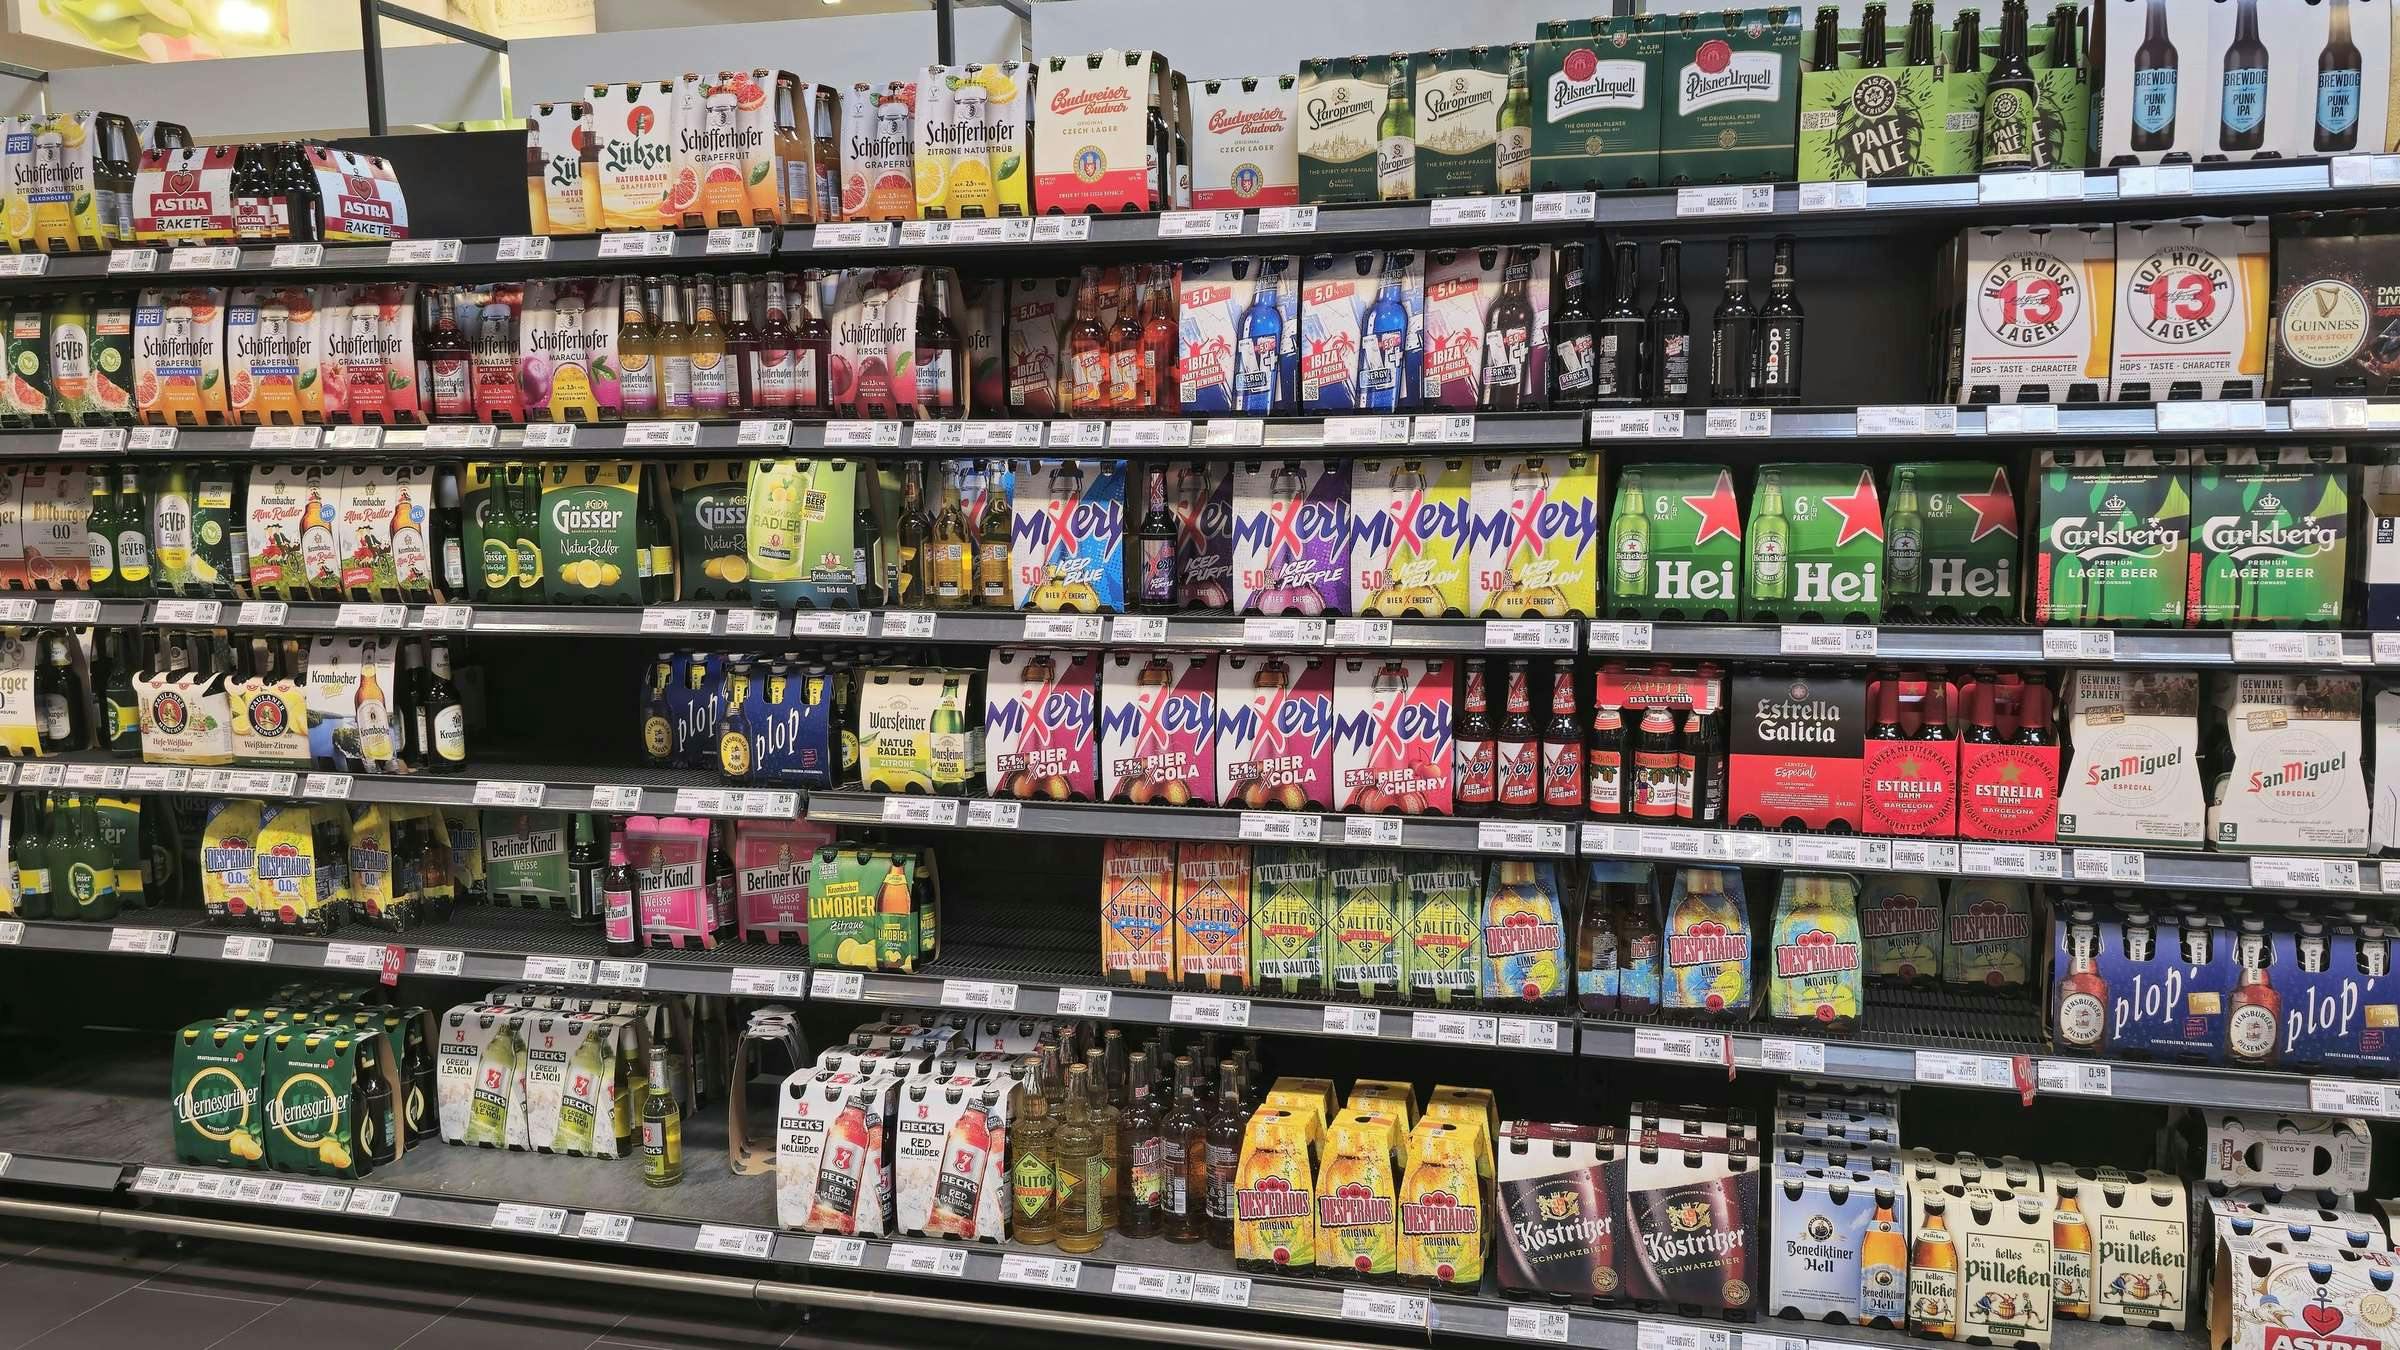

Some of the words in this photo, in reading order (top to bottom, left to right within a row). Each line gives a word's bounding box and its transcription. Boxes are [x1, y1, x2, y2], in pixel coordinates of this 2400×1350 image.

[2135, 71, 2177, 86] BREWDOG
[2224, 72, 2267, 86] BREWDOG
[1855, 78, 1889, 102] MAISEL
[1051, 86, 1131, 114] Budweiser
[1425, 88, 1493, 122] Staropramen
[1867, 97, 1892, 115] FRIENDS
[2144, 93, 2165, 105] PUNK
[2233, 93, 2255, 105] PUNK
[1083, 102, 1128, 116] Budvar
[1307, 98, 1375, 130] Staropramen
[2147, 105, 2160, 116] IPA
[2237, 106, 2250, 116] IPA
[925, 118, 1014, 147] Schöfferhofer
[1062, 126, 1089, 135] CZECH
[1092, 125, 1118, 134] LAGER
[1852, 120, 1903, 153] PALE
[8, 140, 31, 154] FREI
[680, 126, 764, 157] Schöfferhofer
[694, 151, 750, 162] GRAPEFRUIT
[927, 146, 961, 156] ZITRONE
[963, 145, 1013, 155] NATURTRÜB
[1861, 142, 1909, 179] ALE
[15, 163, 84, 186] Schöfferhofer
[153, 198, 209, 214] ASTRA
[156, 218, 210, 231] RAKETE
[1985, 259, 2018, 297] HOP
[2022, 257, 2074, 297] HOUSE
[1996, 279, 2063, 325] 13
[1997, 320, 2058, 343] LAGER
[2291, 318, 2359, 332] GUINNESS
[840, 321, 907, 345] Schöfferhofer
[2294, 333, 2319, 342] EXTRA
[2323, 333, 2354, 341] STOUT
[142, 334, 214, 359] Schöfferhofer
[328, 335, 402, 358] Schöfferhofer
[530, 329, 608, 353] Schöfferhofer
[550, 353, 590, 362] MARACUJA
[857, 347, 888, 356] KIRSCHE
[155, 359, 202, 368] GRAPEFRUIT
[338, 357, 393, 366] GRANATAPFEL
[1311, 351, 1340, 370] IBIZA
[1304, 363, 1343, 379] PARTY-REISEN
[1970, 364, 1992, 374] HOPS
[2000, 364, 2023, 374] TASTE
[2031, 363, 2077, 373] CHARACTER
[260, 496, 296, 507] Krombacher
[806, 497, 826, 507] BEER
[1655, 496, 1668, 514] 6
[252, 508, 271, 521] Alm
[271, 506, 302, 521] Radler
[320, 509, 334, 519] NEU
[552, 498, 623, 534] Gösser
[1653, 513, 1670, 521] PACK
[159, 512, 187, 531] JEVER
[753, 515, 799, 532] RADLER
[2050, 515, 2180, 557] Carlsberg
[1616, 551, 1649, 561] Heineken
[1055, 559, 1090, 574] ICED
[1279, 558, 1318, 577] ICED
[2068, 568, 2115, 579] LAGER
[2121, 568, 2158, 579] BEER
[1063, 567, 1103, 587] BLUE
[1281, 567, 1344, 592] PURPLE
[1518, 569, 1584, 590] YELLOW
[1655, 560, 1736, 599] Hei
[2045, 640, 2078, 651] MEHRWEG
[311, 671, 357, 687] Krombacher
[2080, 675, 2121, 687] GEWINNE
[1629, 693, 1693, 704] naturtrüb
[2080, 690, 2121, 700] SPANIEN
[249, 695, 286, 713] PAULANER
[1755, 699, 1841, 722] Estrella
[869, 712, 926, 731] Warsteiner
[253, 723, 287, 738] MÜNCHEN
[1757, 718, 1837, 743] Galicia
[880, 738, 914, 748] NATUR
[877, 747, 917, 758] RADLER
[1029, 748, 1068, 764] BIER
[880, 759, 915, 767] ZITRONE
[1036, 761, 1080, 776] COLA
[1379, 768, 1414, 783] BIER
[1775, 766, 1816, 779] Especial
[1386, 776, 1447, 795] CHERRY
[1877, 780, 1942, 793] ESTRELLA
[2113, 783, 2153, 792] ESPECIAL
[492, 840, 529, 858] Berliner
[530, 834, 557, 854] Kindl
[512, 859, 538, 872] Weisse
[1335, 870, 1359, 885] VIVA
[1371, 867, 1395, 884] VIDA
[2287, 871, 2319, 882] MEHRWEG
[810, 894, 877, 920] LIMOBIER
[830, 919, 864, 932] Zitrone
[1338, 916, 1393, 931] SALITOS
[1487, 925, 1561, 953] DESPERADOS
[1516, 956, 1537, 966] LIME
[1778, 945, 1858, 975] DESPERADOS
[1335, 967, 1357, 981] VIVA
[1359, 965, 1398, 981] SALITOS
[1804, 975, 1838, 987] MOJITO
[2235, 1009, 2273, 1029] FLENSBURGER
[442, 1045, 478, 1056] BECK'S
[2237, 1040, 2269, 1054] PILSENER
[442, 1065, 472, 1076] LEMON
[174, 1086, 258, 1121] Wernesgrüner
[2346, 1094, 2380, 1106] MEHRWEG
[782, 1120, 823, 1131] BECK'S
[791, 1135, 811, 1147] RED
[781, 1144, 820, 1155] HOLUNDER
[1239, 1190, 1311, 1219] DESPERADOS
[1259, 1221, 1295, 1231] ORIGINAL
[1513, 1213, 1613, 1253] Köstritzer
[2129, 1230, 2156, 1243] helles
[1532, 1243, 1608, 1264] SCHWARZBIER
[1787, 1240, 1854, 1261] Benediktiner
[2100, 1241, 2186, 1270] Pülleken
[1804, 1257, 1834, 1273] Hell
